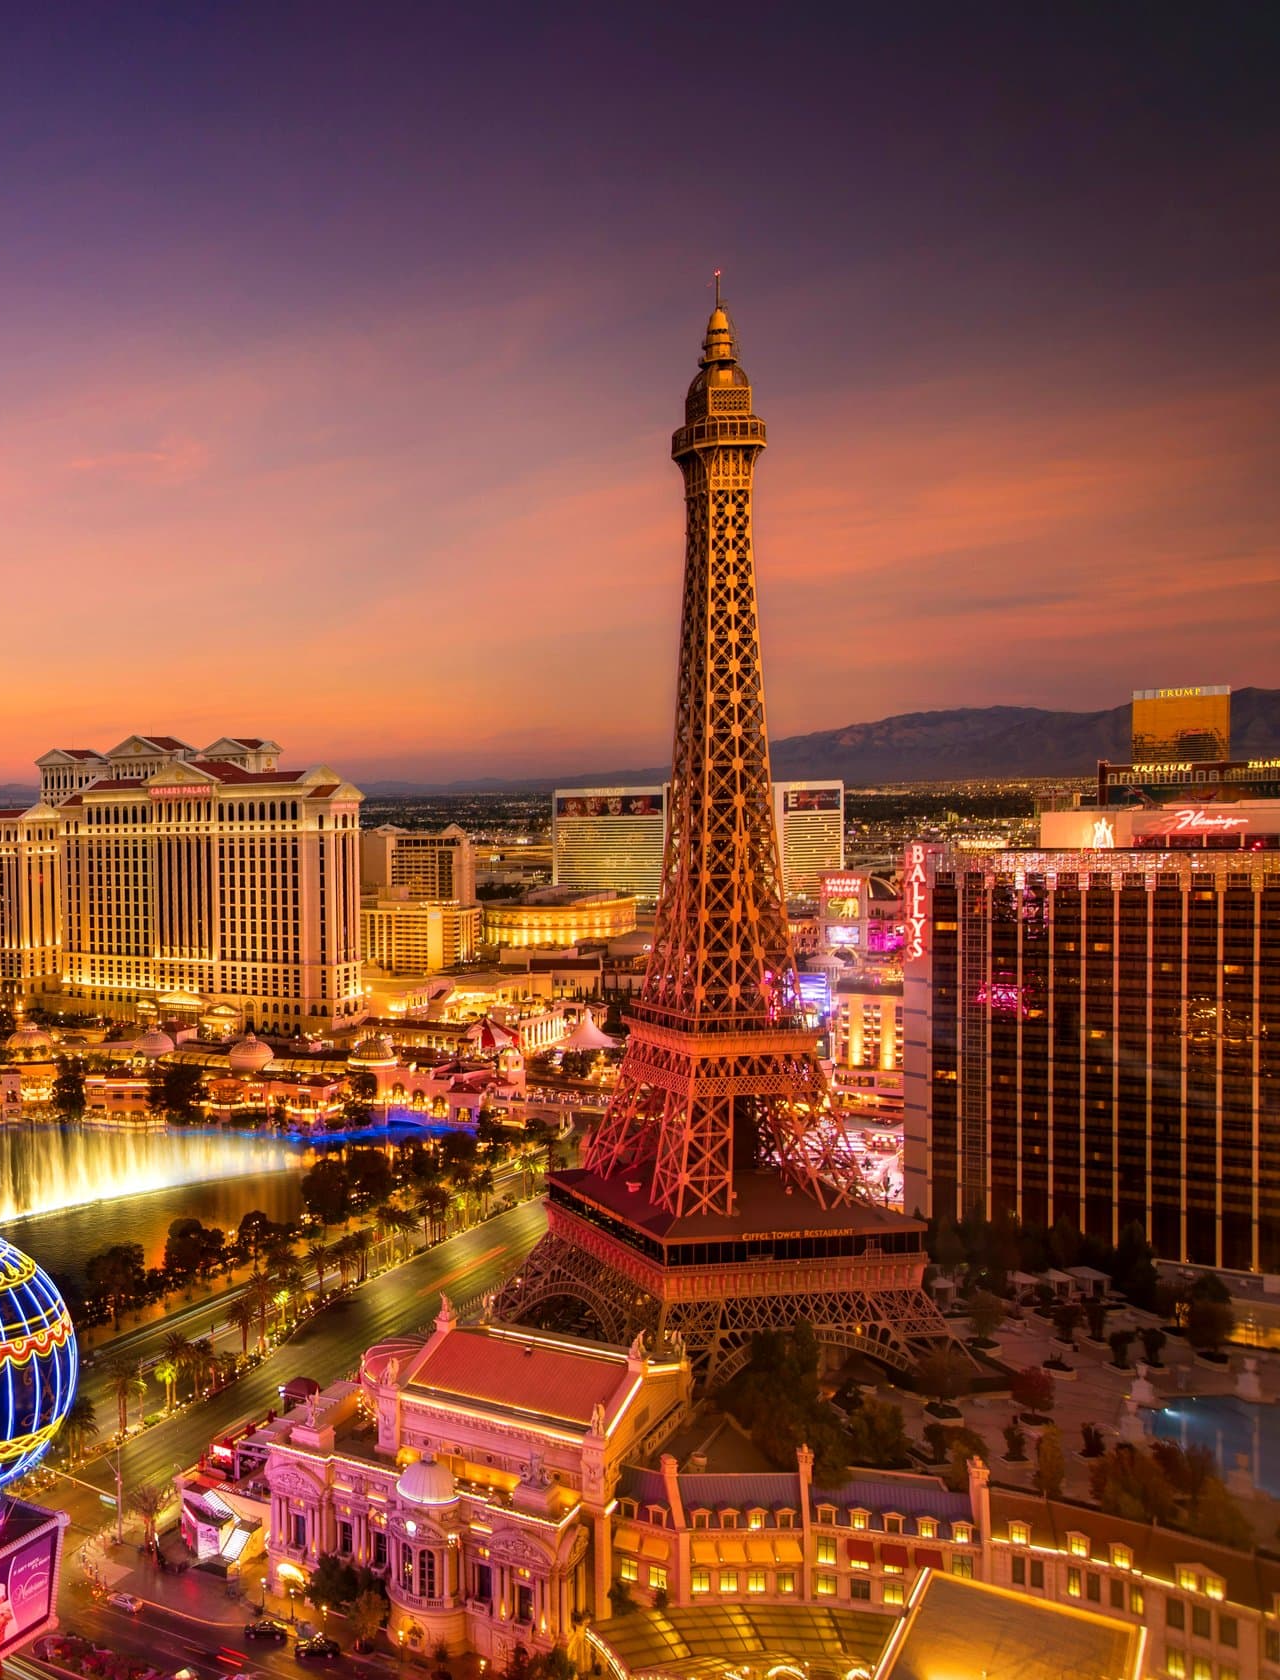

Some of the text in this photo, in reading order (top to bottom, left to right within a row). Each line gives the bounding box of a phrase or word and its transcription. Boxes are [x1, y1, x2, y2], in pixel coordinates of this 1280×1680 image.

[1160, 687, 1201, 697] TRUMP
[1132, 763, 1193, 773] TREASURE
[1174, 809, 1249, 830] Flamingo
[827, 885, 860, 893] PALACE
[742, 1227, 855, 1241] EIFFEL TOWER RESTAURANT
